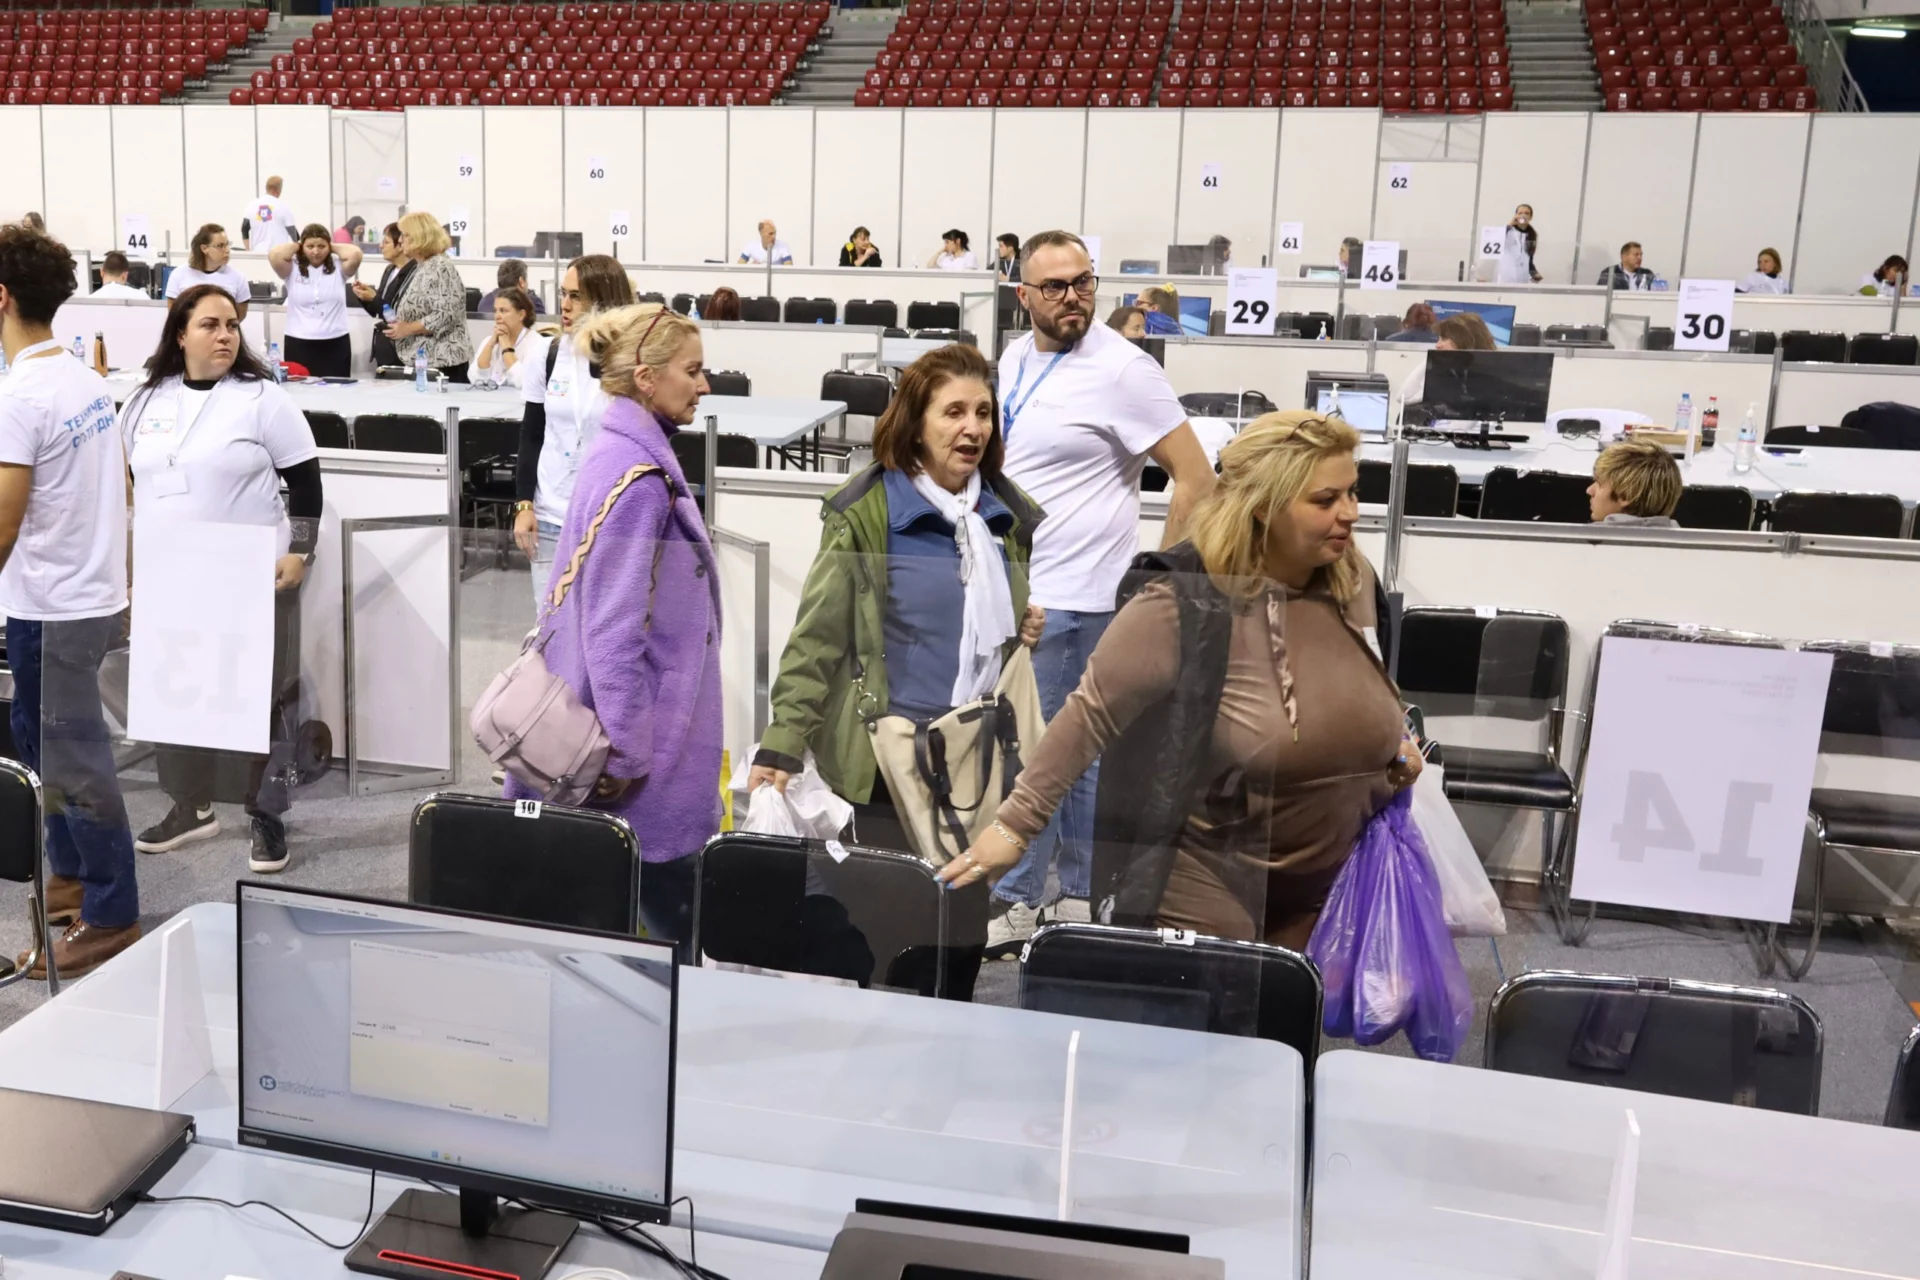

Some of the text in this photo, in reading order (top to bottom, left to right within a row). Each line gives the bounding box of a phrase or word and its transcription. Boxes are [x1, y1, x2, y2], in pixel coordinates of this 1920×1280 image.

[459, 166, 473, 176] 59
[589, 168, 604, 179] 60
[1203, 176, 1218, 187] 61
[1391, 177, 1408, 189] 62
[452, 221, 467, 232] 59
[611, 225, 628, 236] 60
[128, 234, 148, 249] 44
[1282, 237, 1299, 249] 61
[1483, 242, 1501, 255] 62
[1364, 265, 1394, 283] 46
[1232, 299, 1270, 324] 29
[1681, 313, 1725, 340] 30
[521, 801, 536, 814] 10
